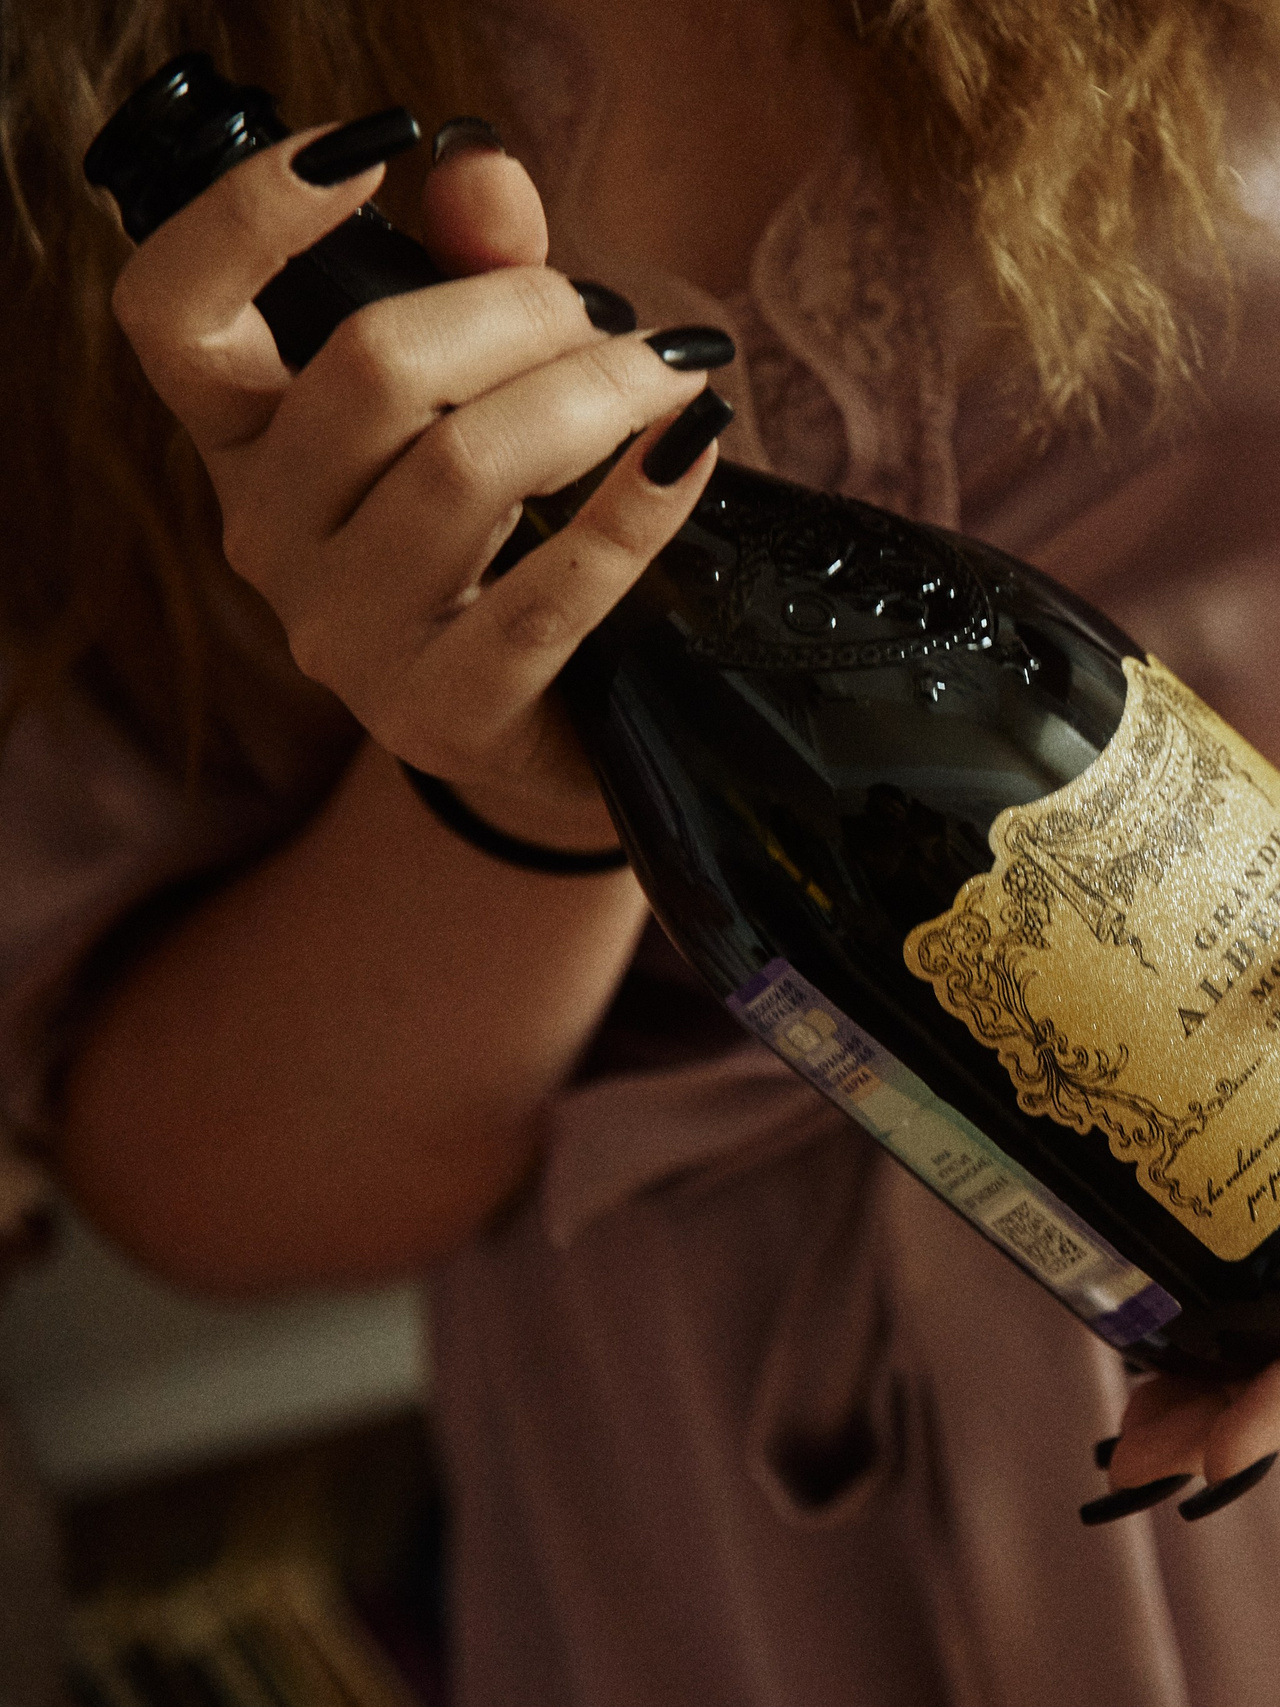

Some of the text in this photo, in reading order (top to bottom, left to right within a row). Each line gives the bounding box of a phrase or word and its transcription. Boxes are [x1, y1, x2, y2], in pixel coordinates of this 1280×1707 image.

[1207, 1178, 1224, 1206] ha
[1226, 1149, 1262, 1187] voluto
[1248, 1185, 1268, 1222] per
